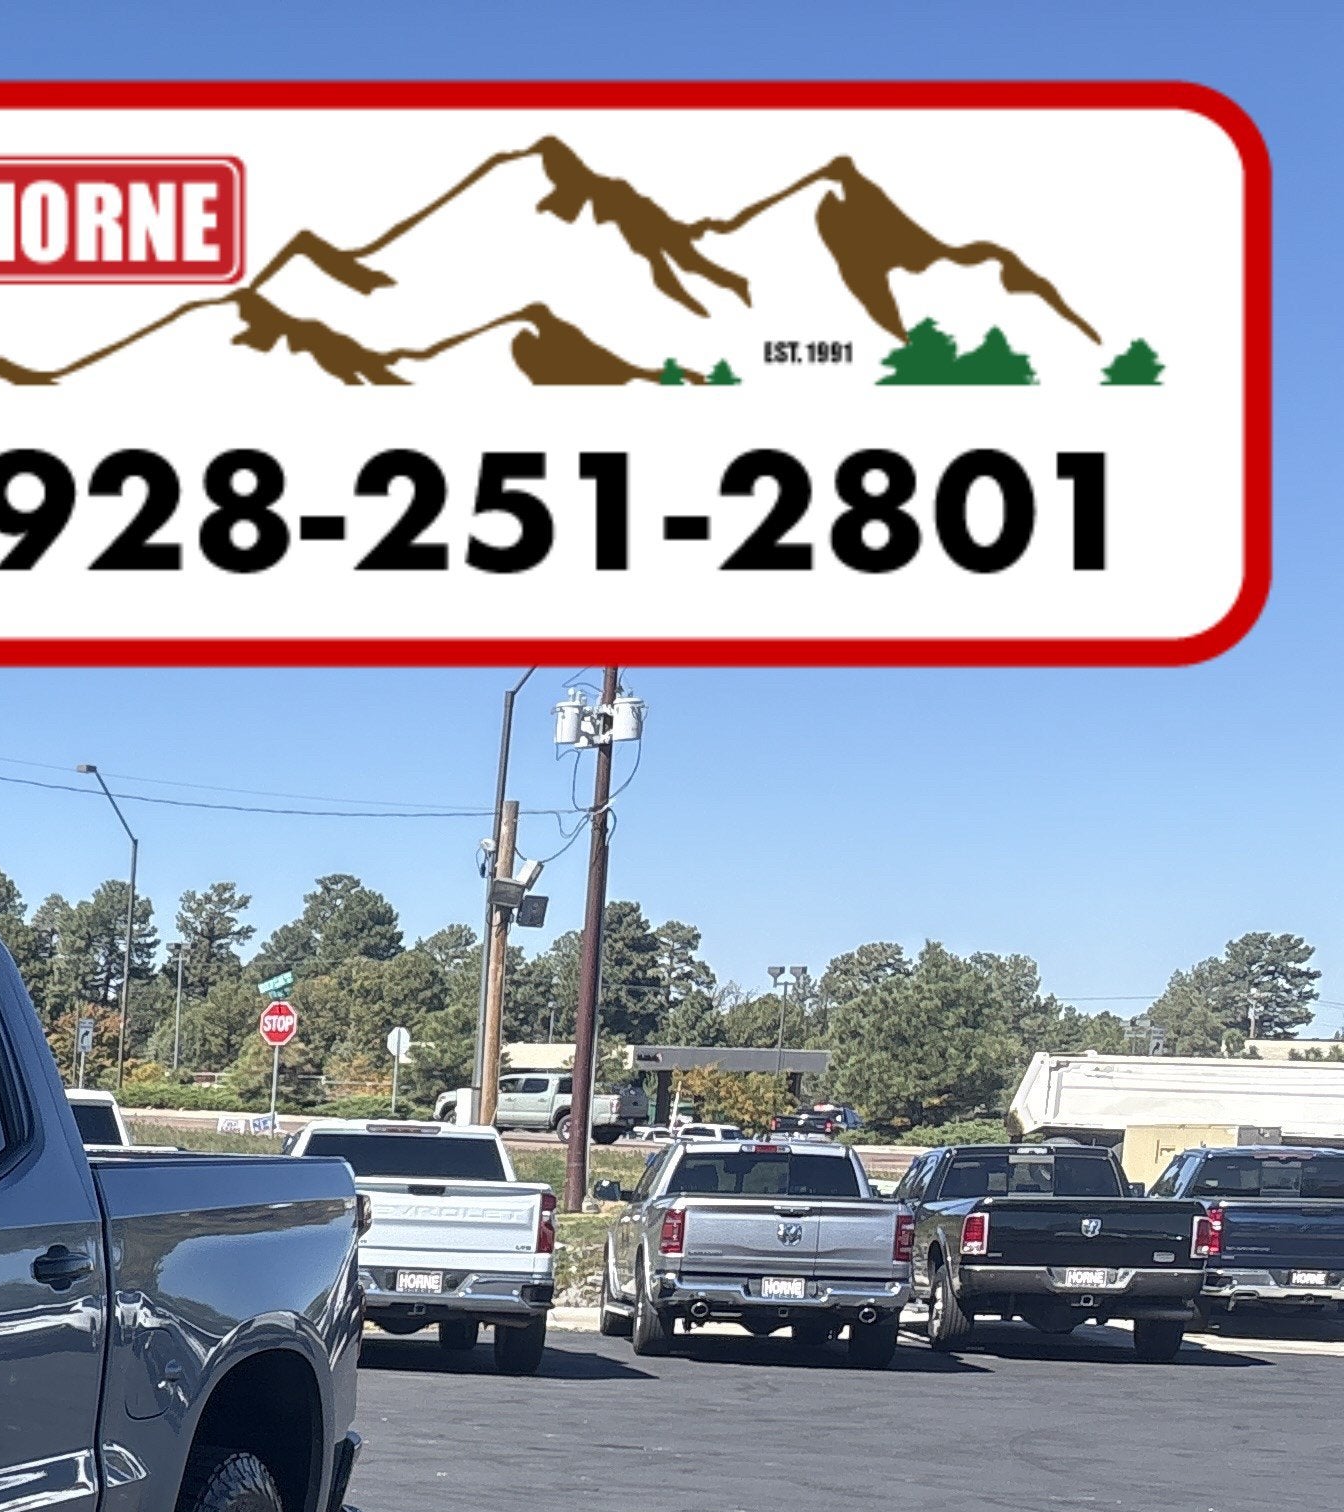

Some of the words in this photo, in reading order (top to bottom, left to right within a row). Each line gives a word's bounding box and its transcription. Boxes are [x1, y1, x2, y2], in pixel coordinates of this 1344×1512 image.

[262, 1014, 294, 1033] STOP
[399, 1273, 440, 1290] HORNE
[1067, 1268, 1105, 1285] HORNE
[1292, 1272, 1327, 1285] HORNE
[764, 1280, 802, 1296] HORNE
